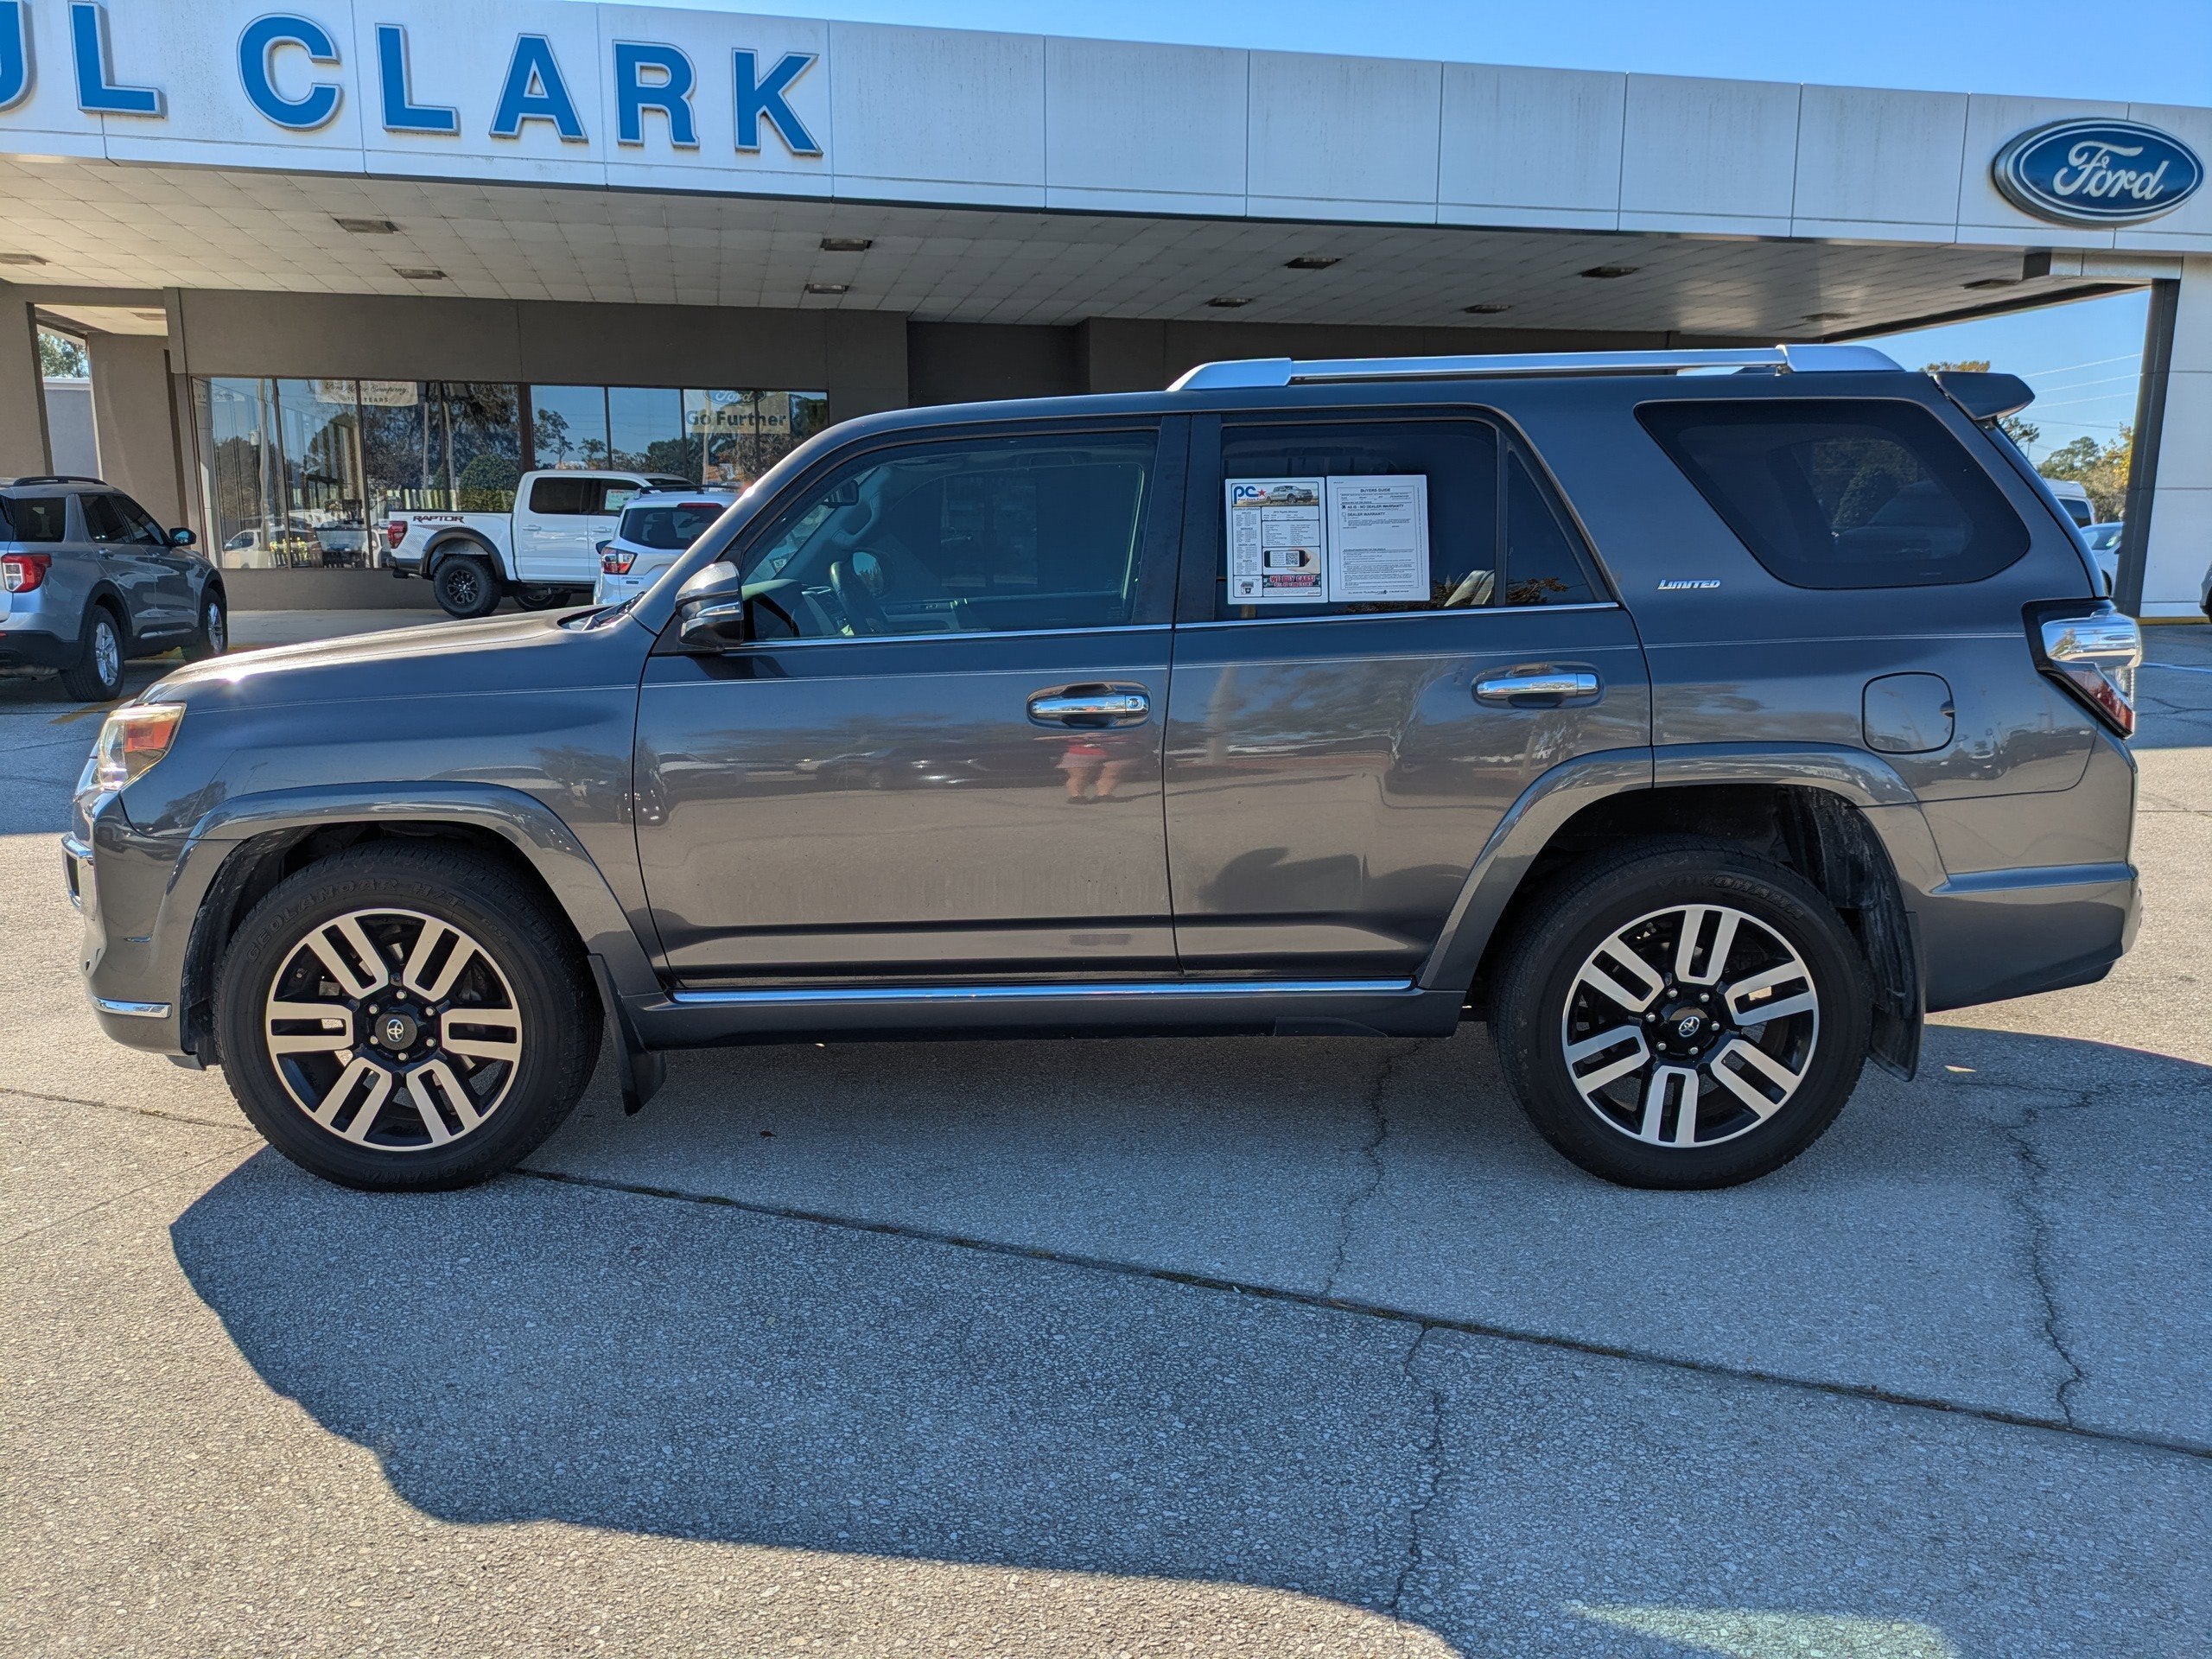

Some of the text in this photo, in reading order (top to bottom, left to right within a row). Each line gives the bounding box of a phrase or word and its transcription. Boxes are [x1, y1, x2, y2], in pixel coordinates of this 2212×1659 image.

[237, 12, 823, 156] CLARK
[2052, 140, 2170, 200] Ford
[685, 410, 787, 427] Go Further
